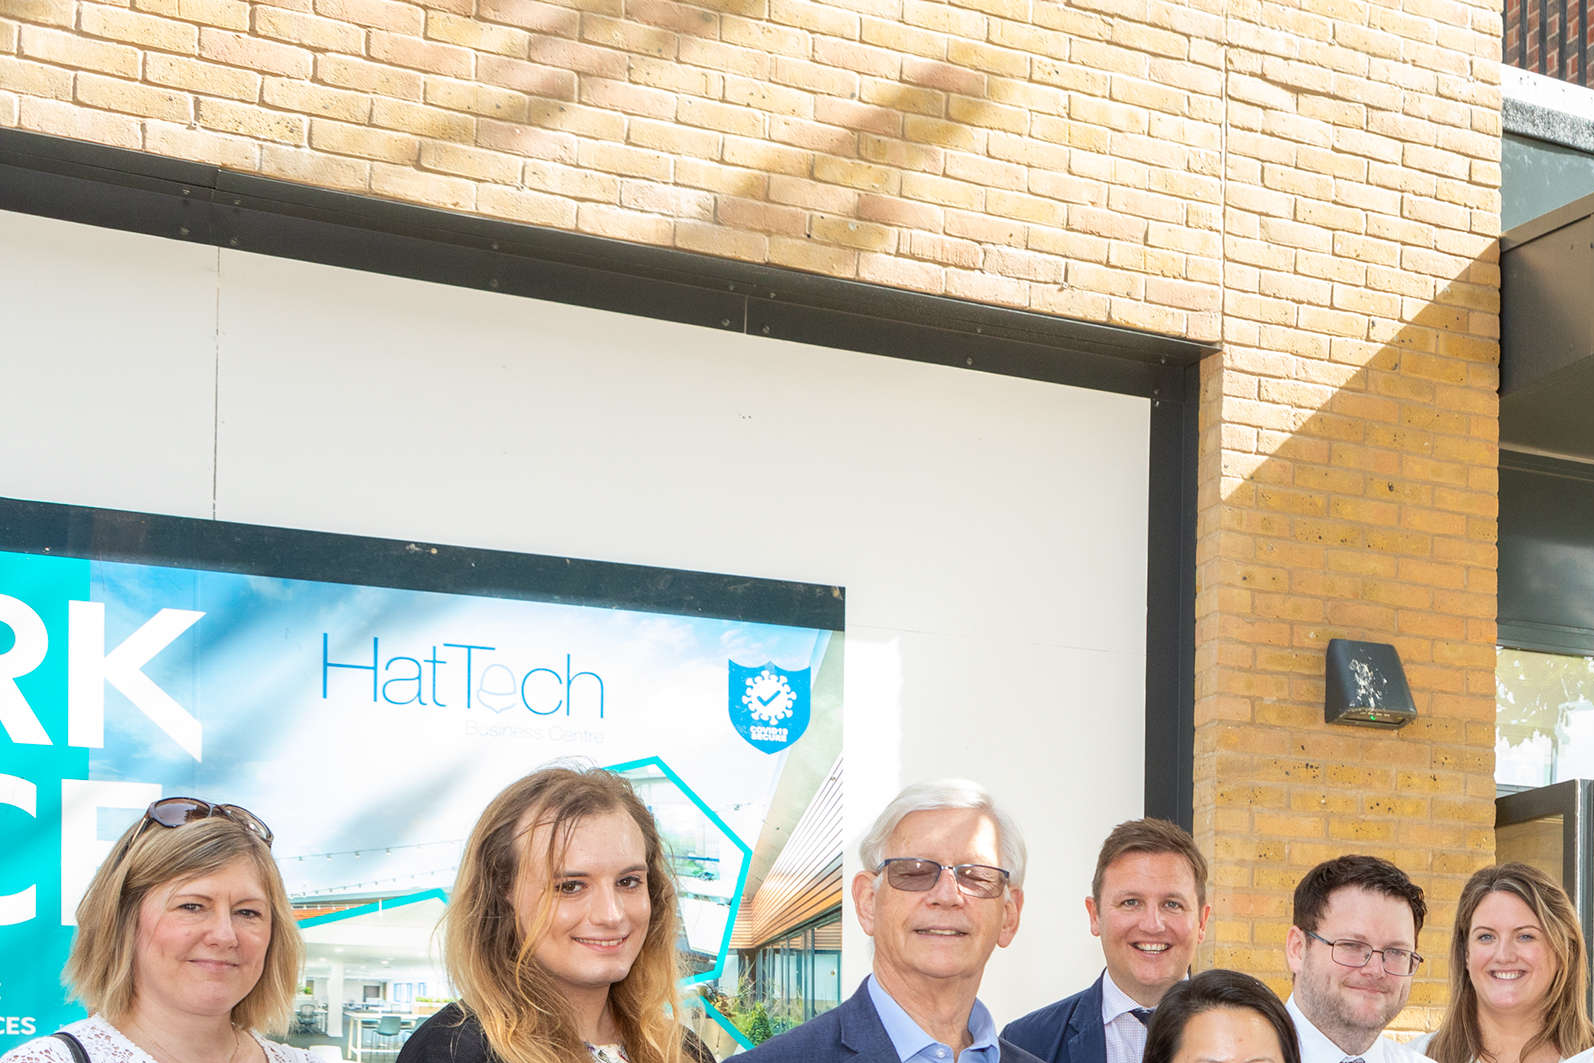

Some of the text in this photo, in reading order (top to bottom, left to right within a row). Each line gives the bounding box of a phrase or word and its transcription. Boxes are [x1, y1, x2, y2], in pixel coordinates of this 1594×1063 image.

[322, 632, 605, 719] HatTech
[465, 719, 605, 745] Business Centre
[750, 725, 789, 736] COVID19
[751, 733, 788, 743] SECURE
